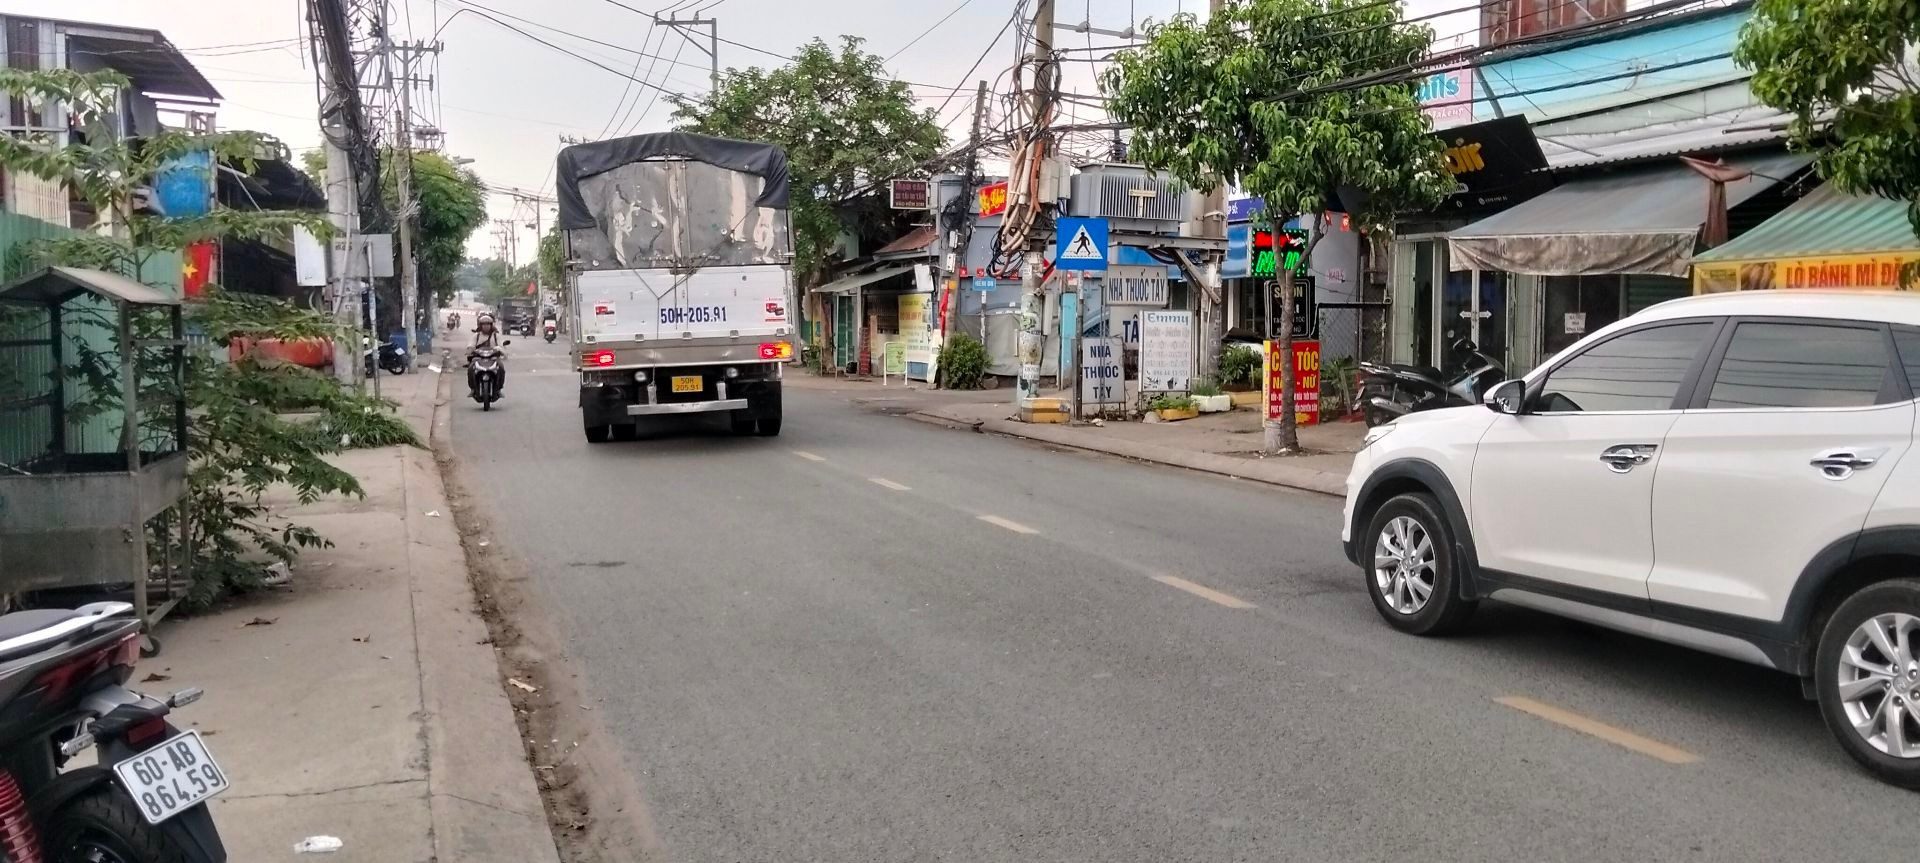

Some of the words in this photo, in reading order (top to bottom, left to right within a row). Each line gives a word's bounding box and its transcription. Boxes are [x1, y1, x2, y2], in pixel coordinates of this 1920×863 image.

[1109, 271, 1123, 301] NHÀ
[1126, 268, 1150, 302] THUỐC
[1151, 271, 1165, 301] TÂY
[1786, 260, 1804, 289] LÒ
[1808, 260, 1851, 288] BÁNH
[1856, 256, 1877, 287] MÌ
[661, 306, 727, 324] 50H-205.91
[1147, 312, 1189, 326] Emmy
[1123, 314, 1140, 343] TÂ
[1090, 342, 1111, 358] NHÀ
[1296, 346, 1319, 372] TÓC
[1084, 361, 1119, 379] THUỐC
[1302, 373, 1317, 389] NỮ
[132, 741, 196, 786] 60-AB
[142, 764, 220, 817] 864.59
